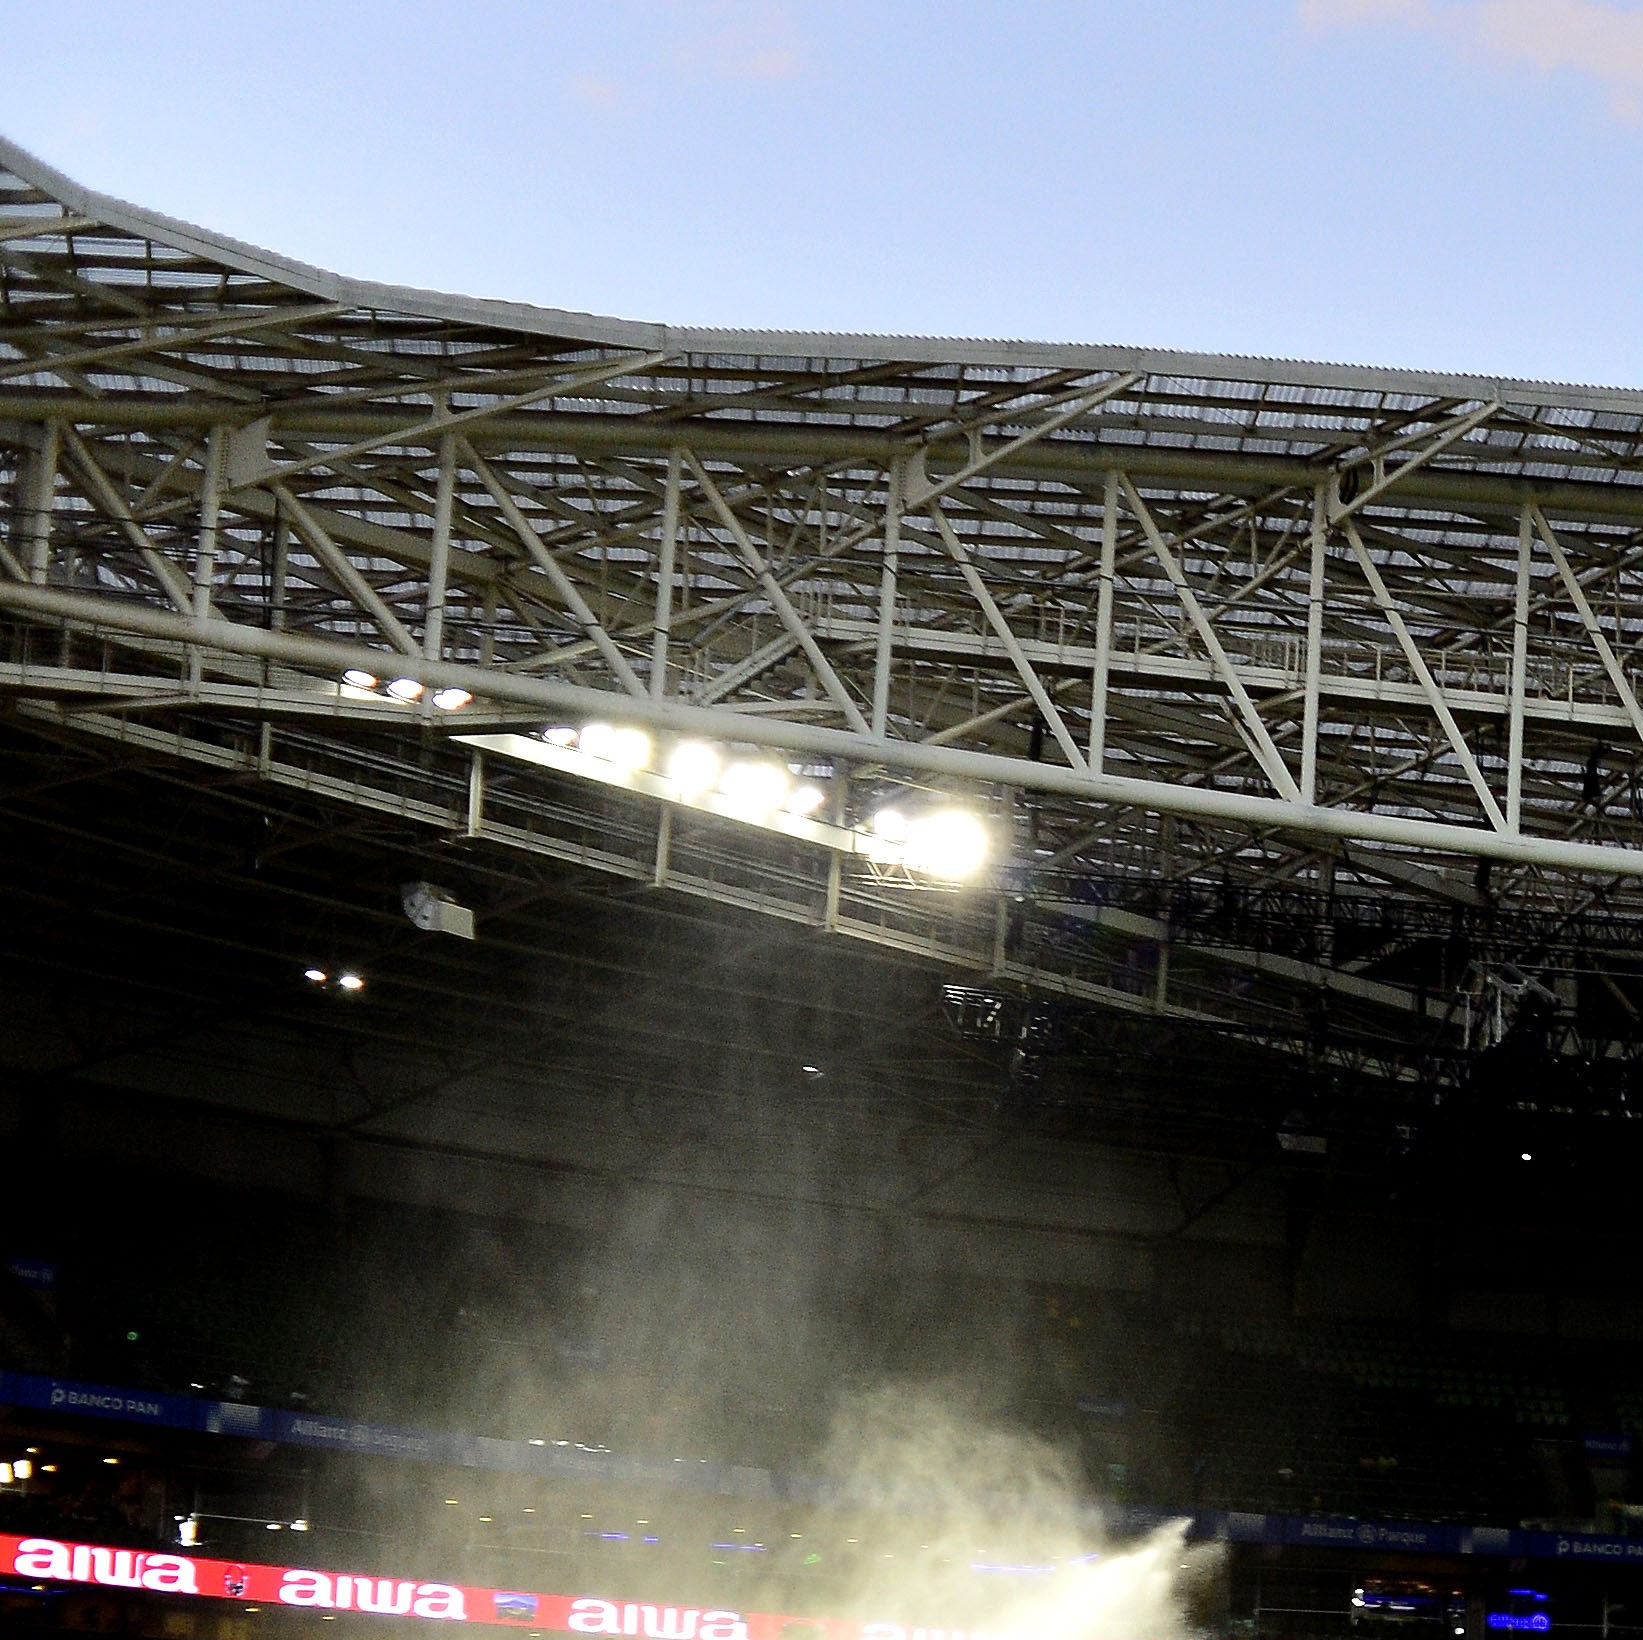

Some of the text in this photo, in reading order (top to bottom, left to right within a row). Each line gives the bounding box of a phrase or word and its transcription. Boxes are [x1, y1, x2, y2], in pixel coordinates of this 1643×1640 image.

[67, 1390, 161, 1417] BANCO PAN
[14, 1539, 197, 1594] aiwa
[1571, 1540, 1621, 1558] BANCO
[279, 1569, 467, 1620] aiwa
